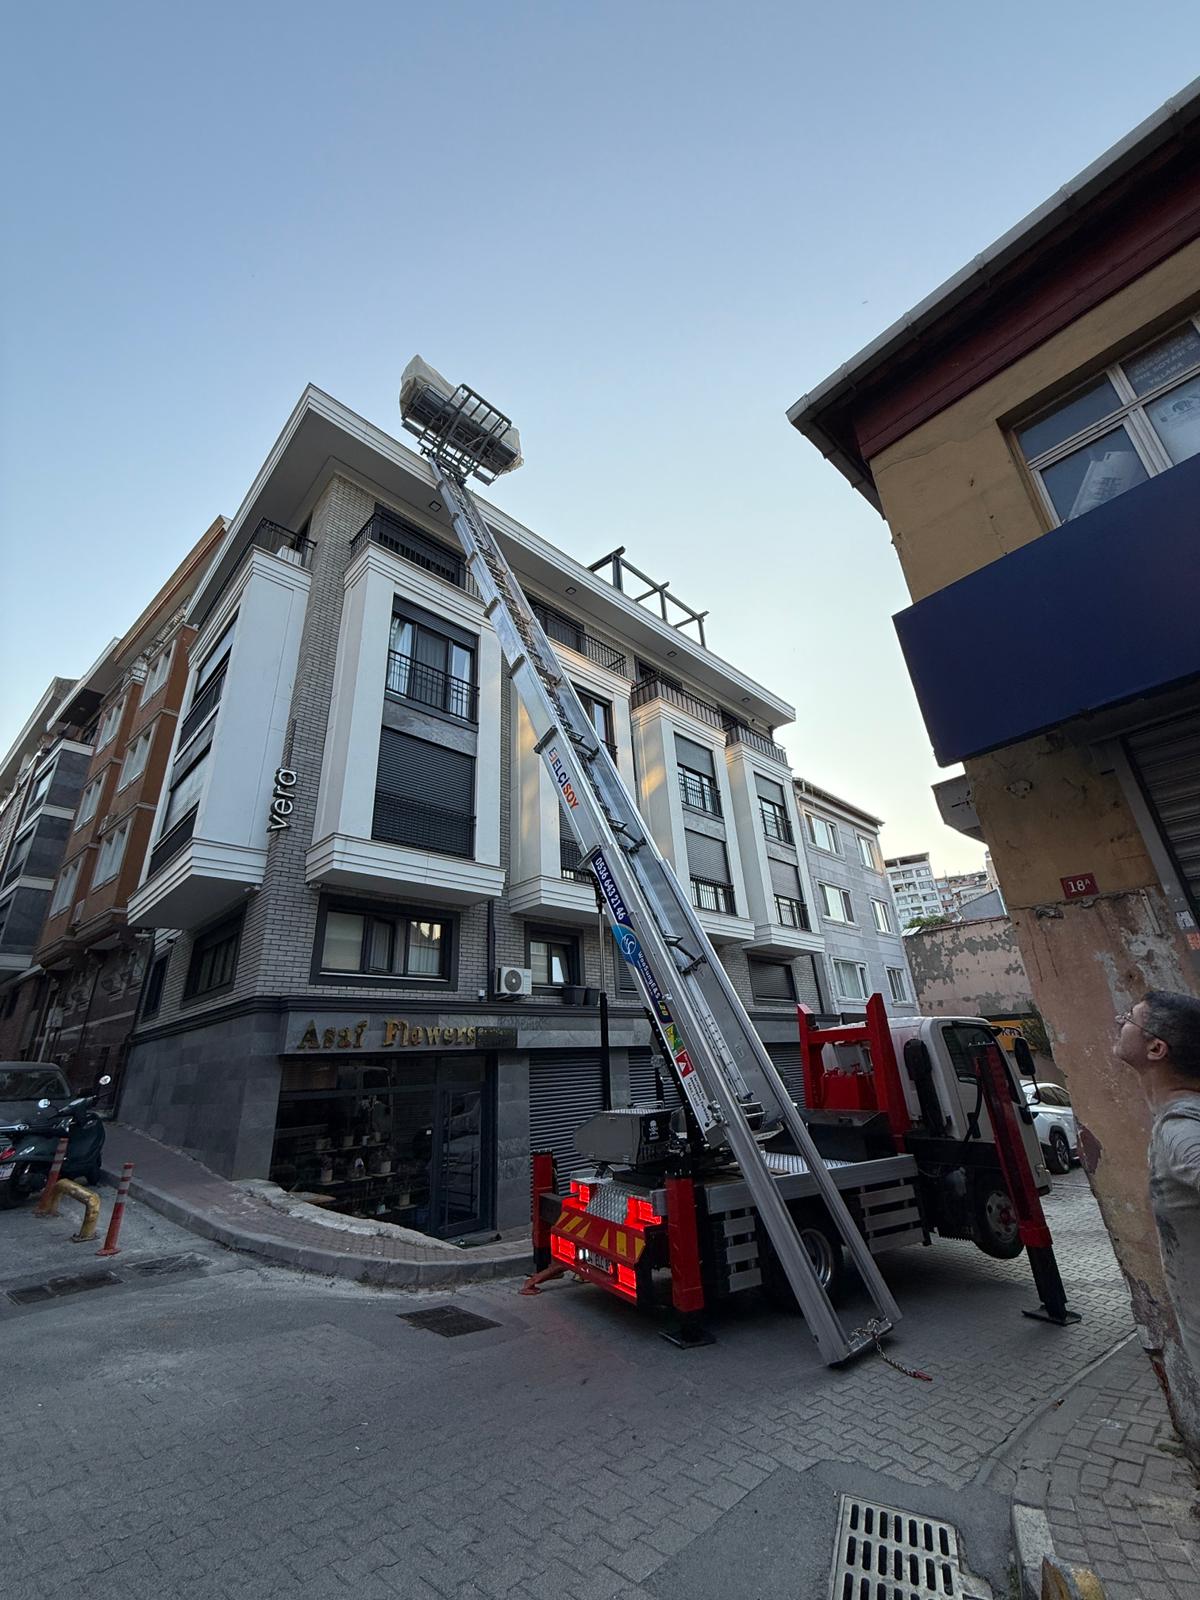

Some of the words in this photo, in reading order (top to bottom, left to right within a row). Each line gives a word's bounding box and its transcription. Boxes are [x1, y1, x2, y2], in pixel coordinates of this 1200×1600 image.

[269, 768, 298, 831] vera
[594, 857, 608, 880] 0536
[603, 879, 616, 897] 643
[610, 896, 621, 909] 21
[615, 906, 627, 920] 46
[297, 1019, 368, 1049] Asaf
[381, 1018, 477, 1048] Flowers
